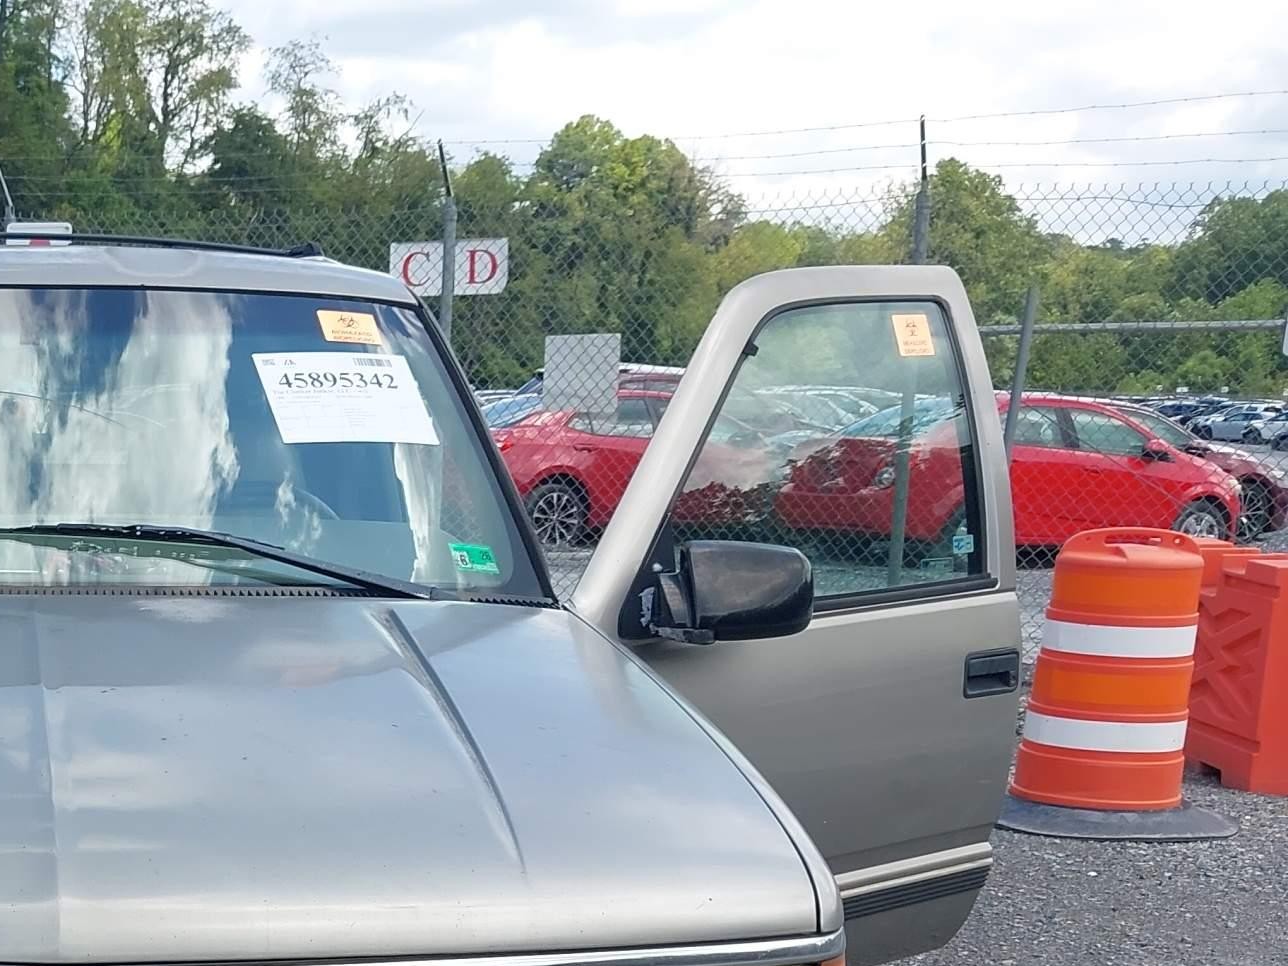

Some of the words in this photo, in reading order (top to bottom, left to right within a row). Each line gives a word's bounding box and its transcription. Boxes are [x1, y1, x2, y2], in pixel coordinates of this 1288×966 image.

[402, 251, 431, 287] C
[465, 249, 498, 284] D
[278, 371, 398, 390] 45895342
